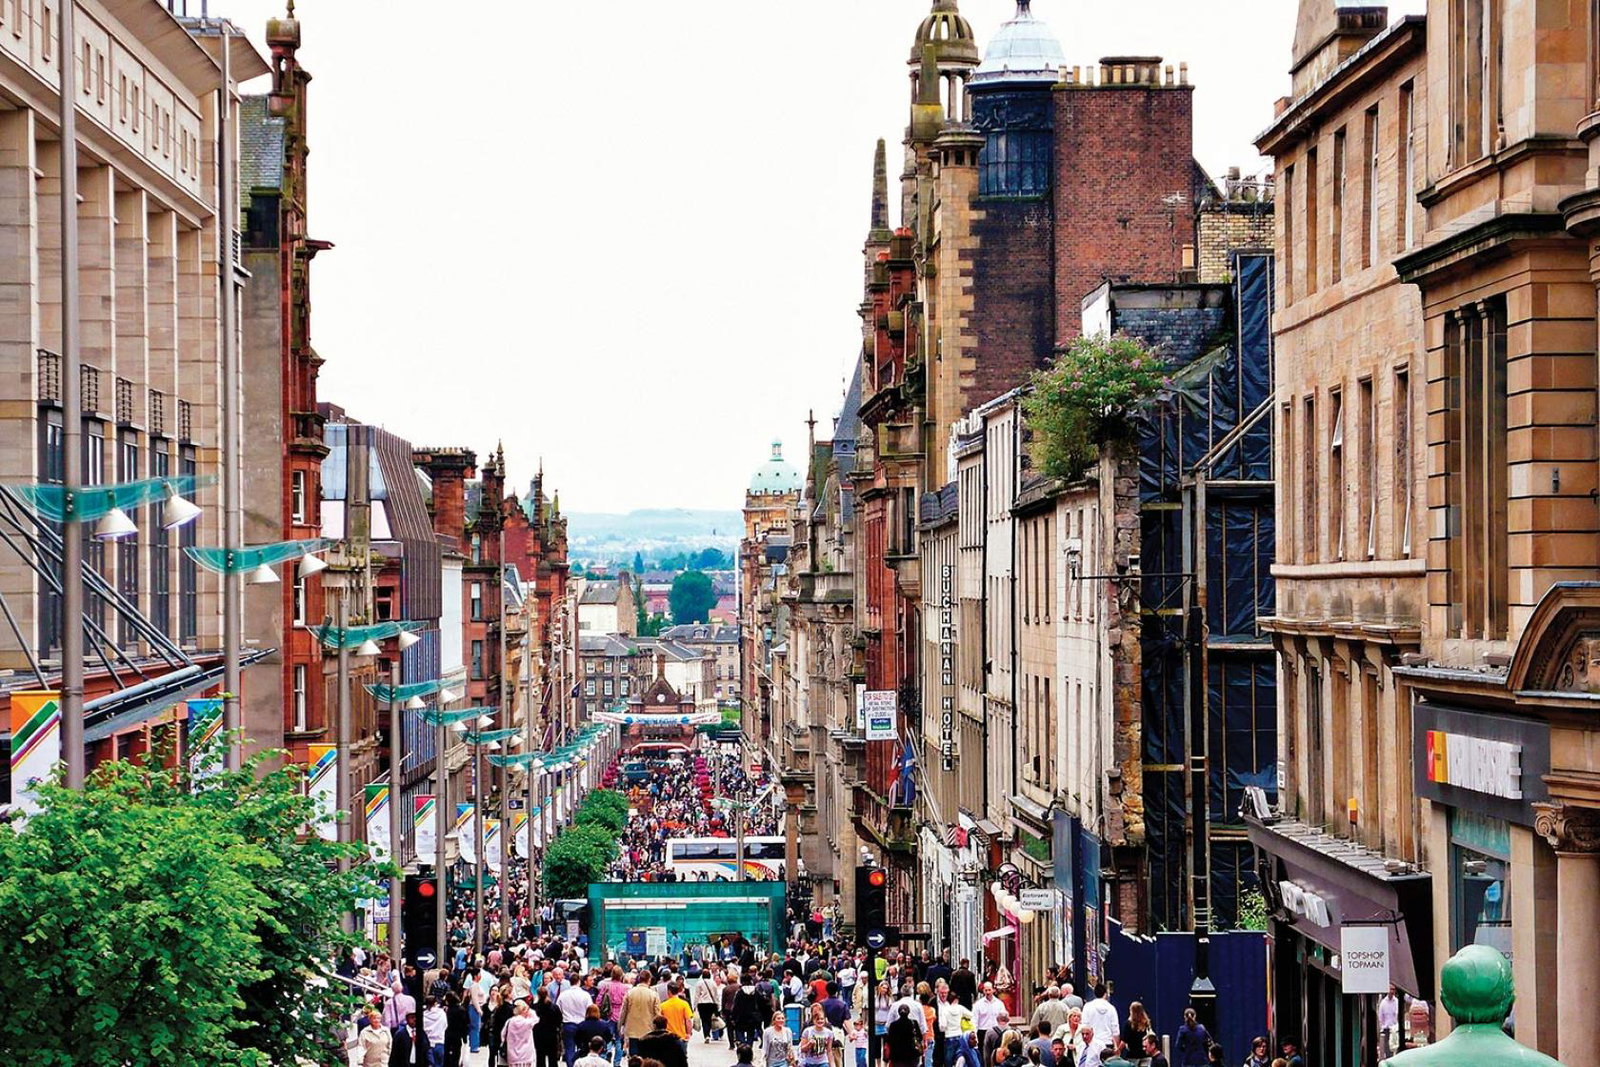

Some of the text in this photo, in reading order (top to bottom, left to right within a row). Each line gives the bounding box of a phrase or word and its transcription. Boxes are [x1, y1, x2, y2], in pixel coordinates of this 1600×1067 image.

[942, 566, 951, 771] BUCHANAN HOTEL
[699, 885, 752, 895] STREET
[1347, 951, 1385, 960] TOPSHOP
[1348, 960, 1385, 969] TOPMAN
